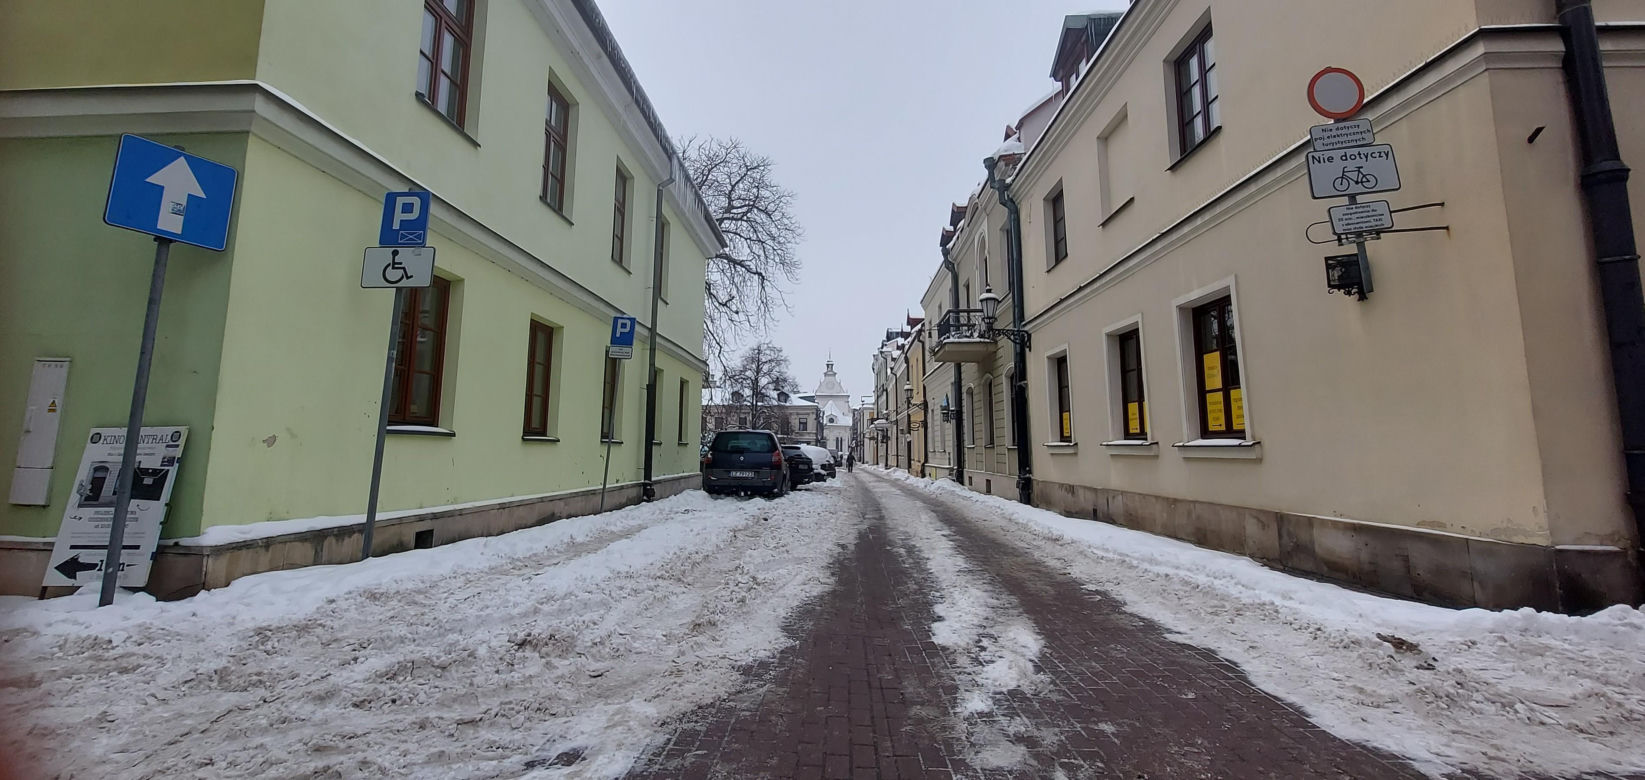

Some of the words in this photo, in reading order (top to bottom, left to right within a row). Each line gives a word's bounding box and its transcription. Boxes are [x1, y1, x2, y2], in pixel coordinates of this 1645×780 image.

[1326, 129, 1371, 140] elektrycznych
[1335, 124, 1360, 132] dotyczy
[1311, 154, 1334, 165] Nie
[1340, 150, 1390, 162] dotyczy
[392, 196, 421, 230] P
[616, 319, 631, 337] P
[137, 434, 170, 444] NTRAL
